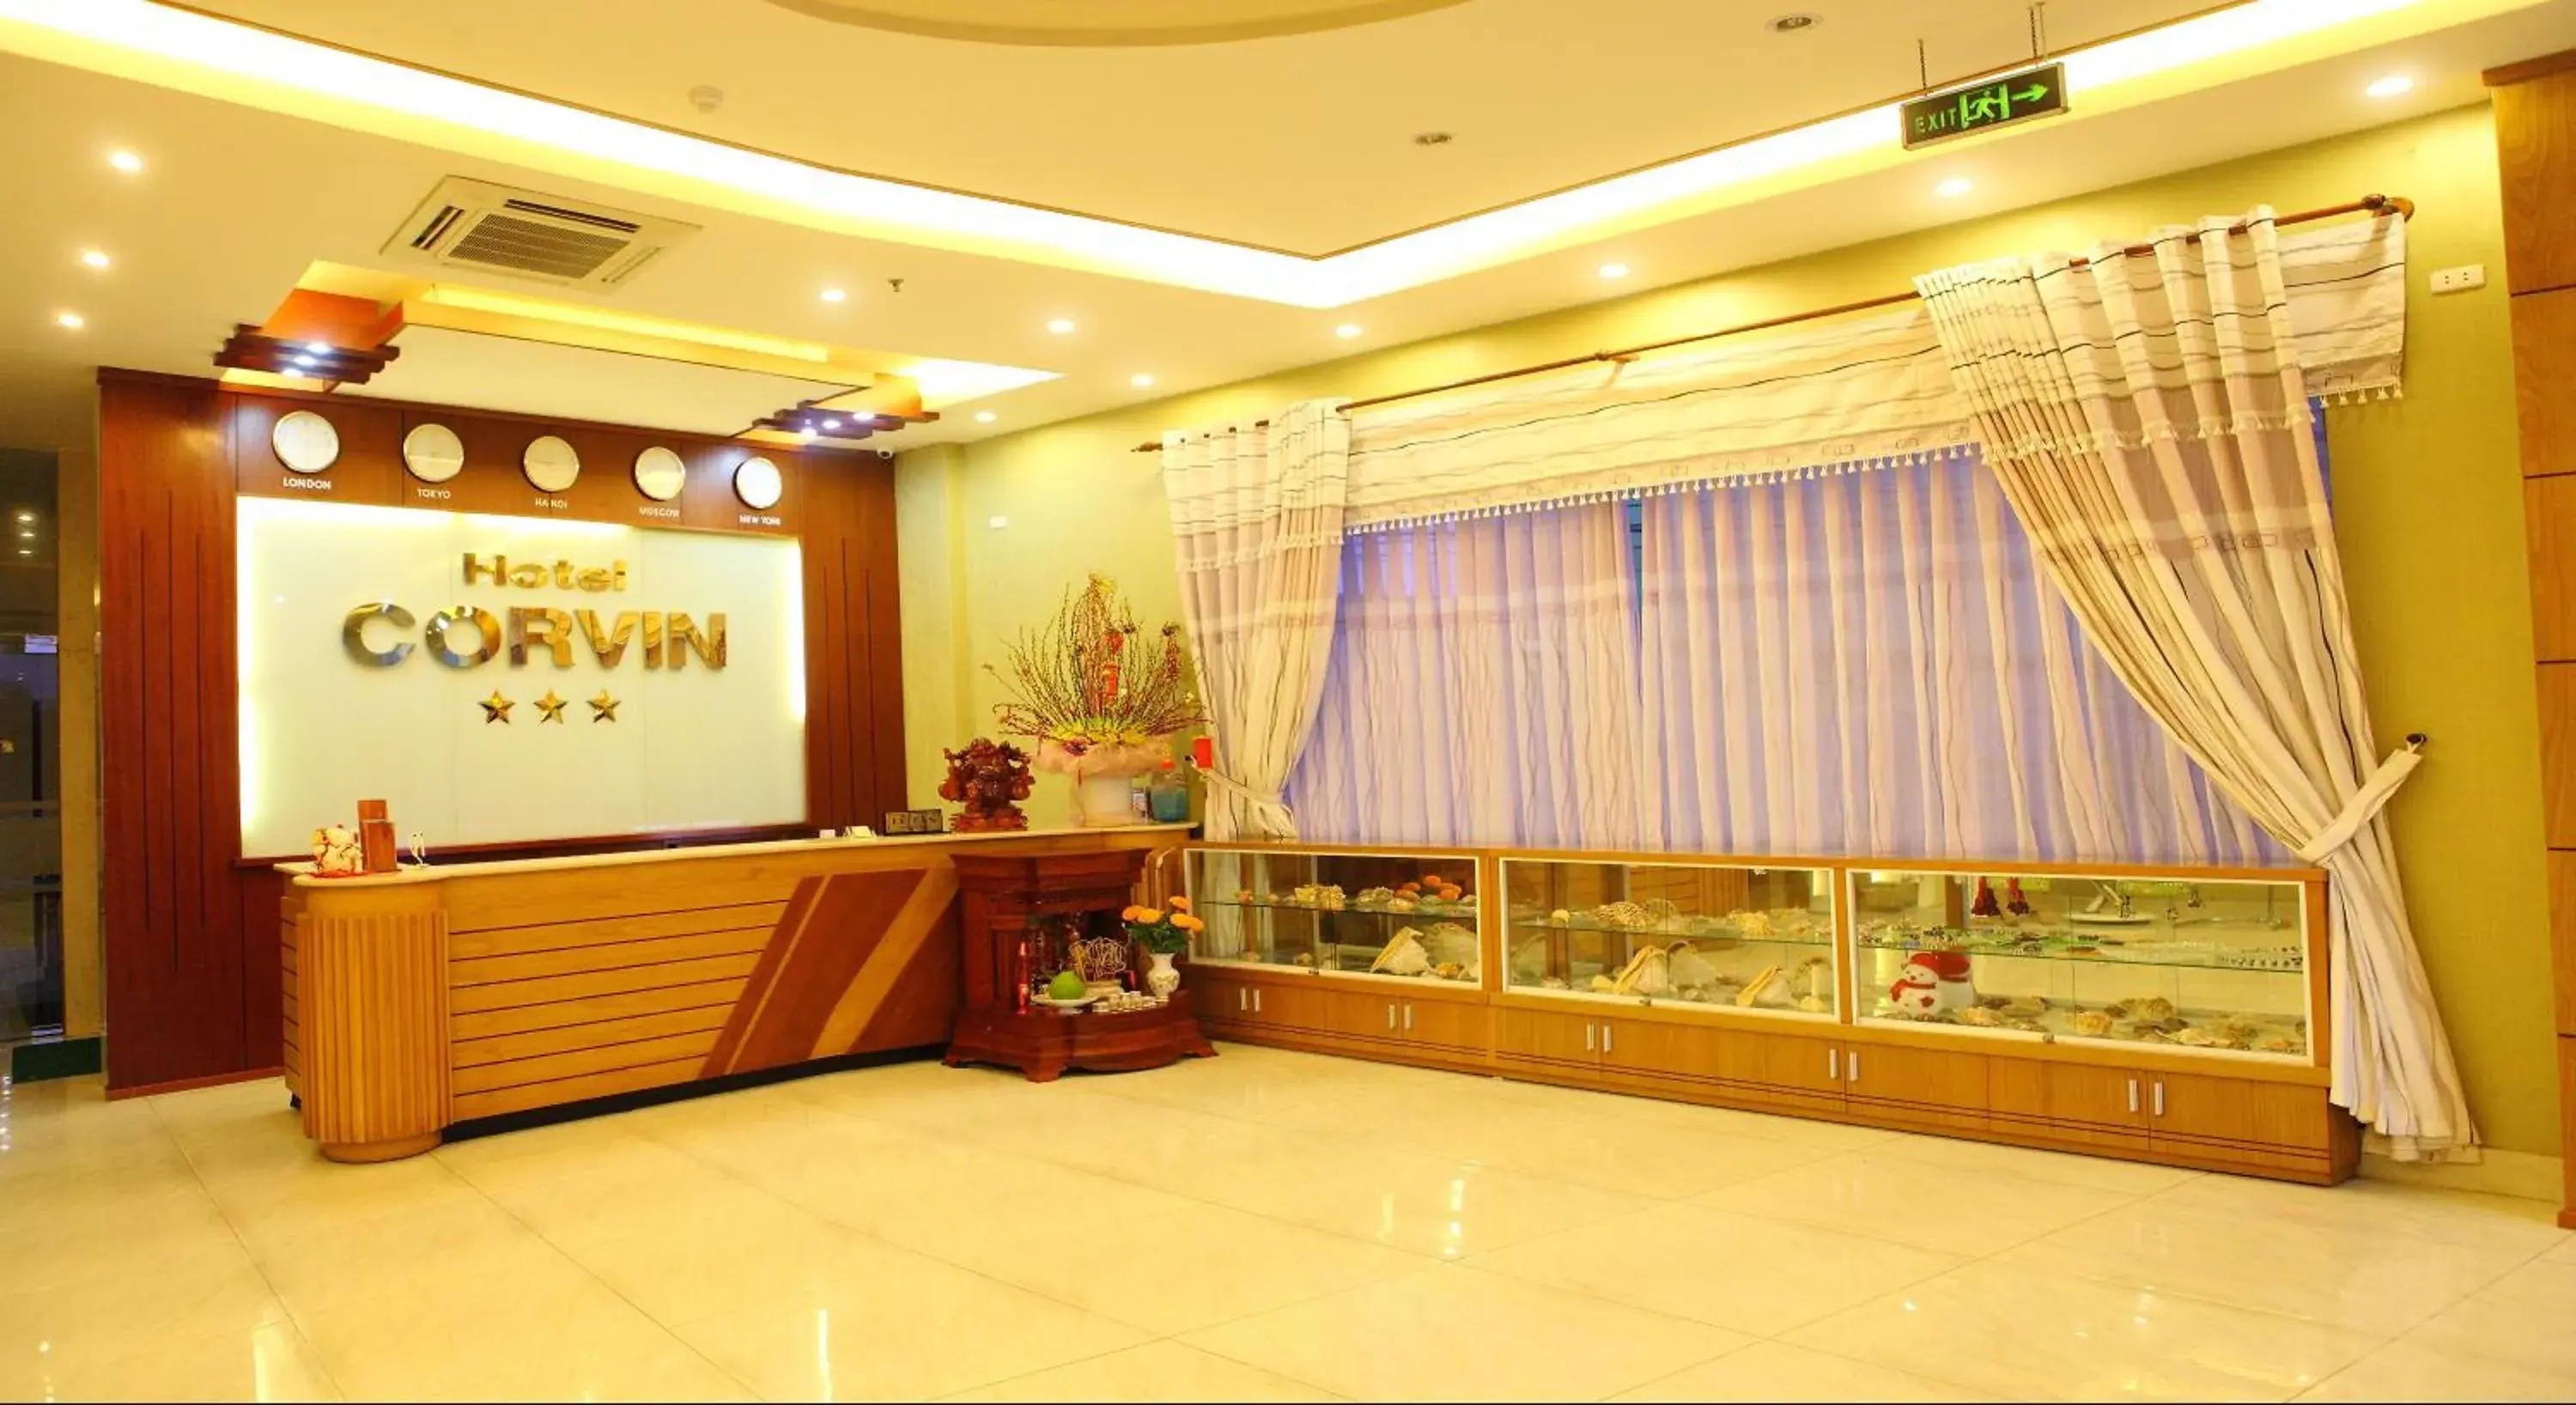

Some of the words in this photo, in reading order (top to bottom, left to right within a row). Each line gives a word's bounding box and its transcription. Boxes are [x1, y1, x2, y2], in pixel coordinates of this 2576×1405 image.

[1914, 107, 1957, 133] EXIT
[283, 477, 331, 490] LONDON
[417, 488, 451, 499] TOKYO
[639, 507, 680, 518] MOSCOW
[739, 514, 760, 524] NEW
[463, 552, 629, 592] Hotel
[343, 602, 727, 670] CORVIN
